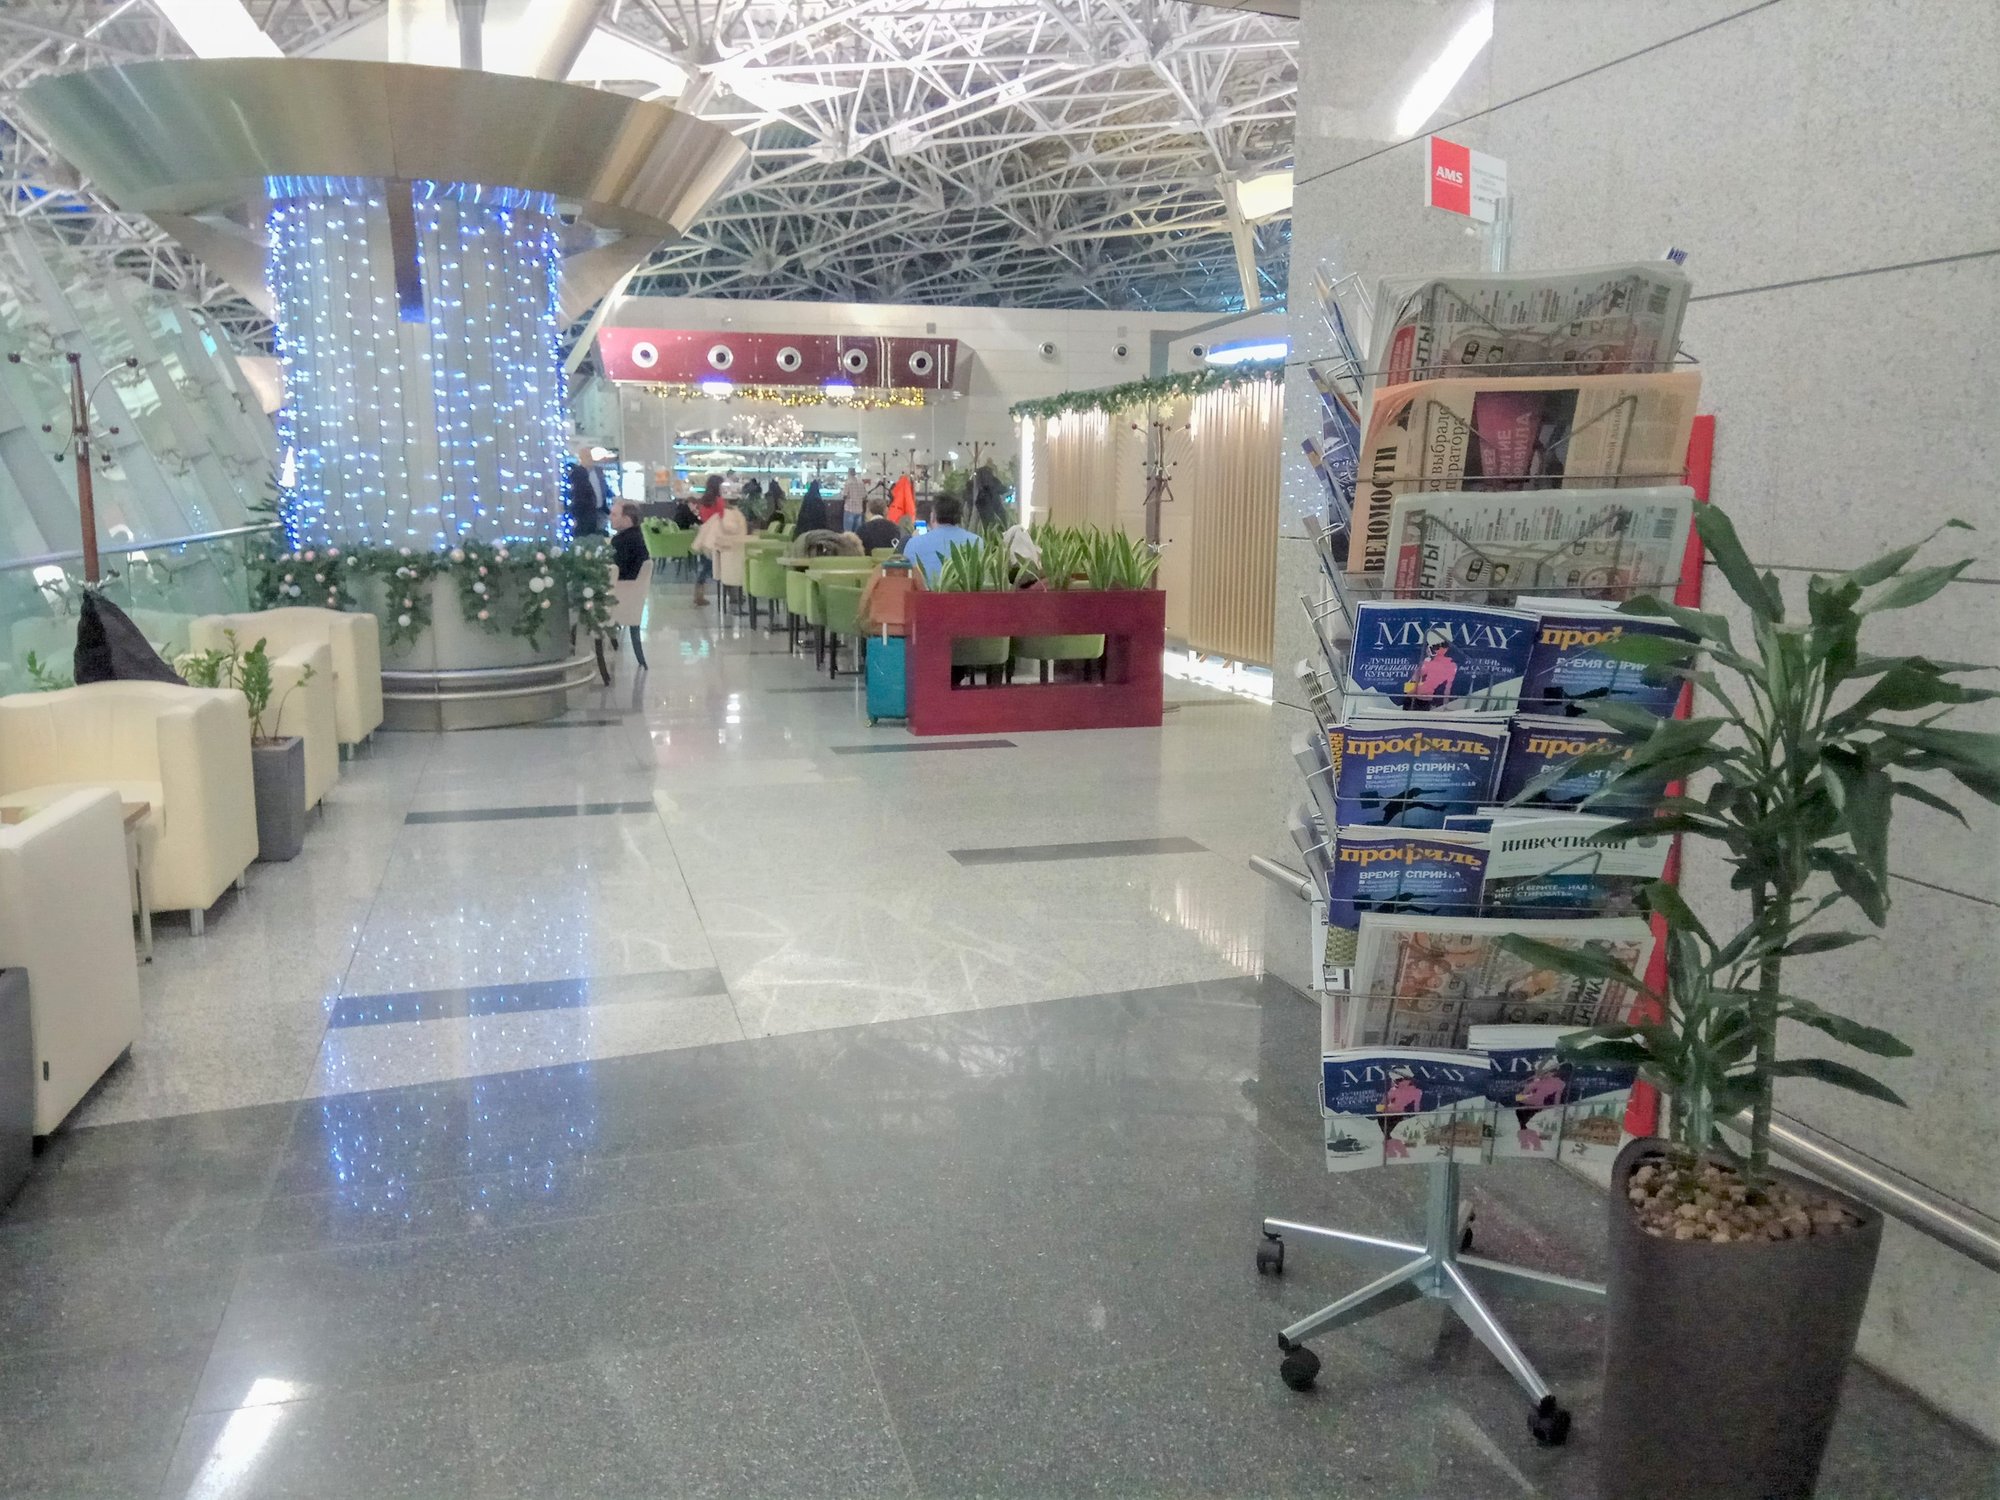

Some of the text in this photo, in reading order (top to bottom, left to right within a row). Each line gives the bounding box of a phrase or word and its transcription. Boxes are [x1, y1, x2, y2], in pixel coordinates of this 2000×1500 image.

[1436, 166, 1463, 184] AMS
[1346, 732, 1491, 760] профиль
[1366, 763, 1410, 774] ВРЕМЯ
[1340, 843, 1482, 867] профиль
[1360, 869, 1400, 880] ВРЕМЯ
